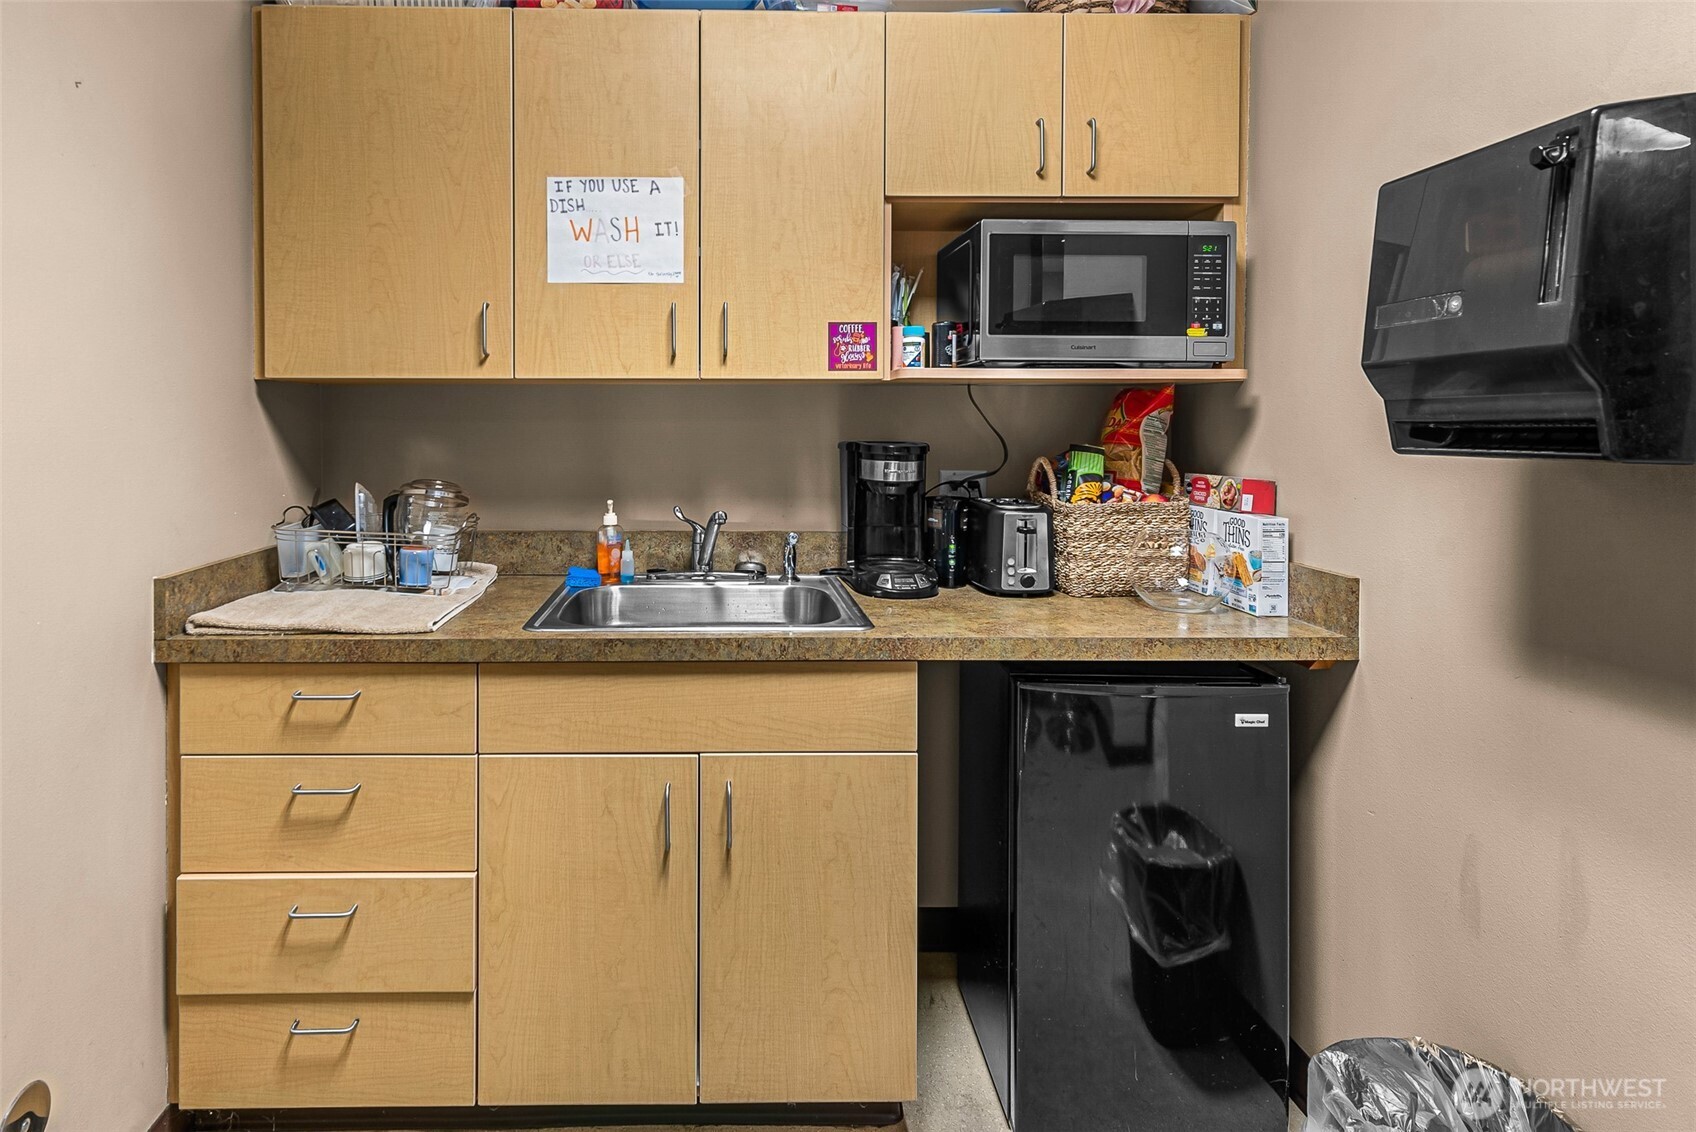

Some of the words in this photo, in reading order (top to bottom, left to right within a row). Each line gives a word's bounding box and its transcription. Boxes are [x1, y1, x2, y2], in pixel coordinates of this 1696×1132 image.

[554, 180, 573, 193] IF
[579, 178, 605, 193] YOU
[611, 178, 640, 193] USE
[649, 179, 662, 196] A
[569, 215, 640, 244] WASH
[654, 221, 679, 237] IT!
[583, 253, 602, 269] OR
[606, 253, 642, 269] ELSE
[839, 323, 863, 333] COFFEE
[1229, 517, 1246, 528] GOOD
[1223, 521, 1251, 548] THINS
